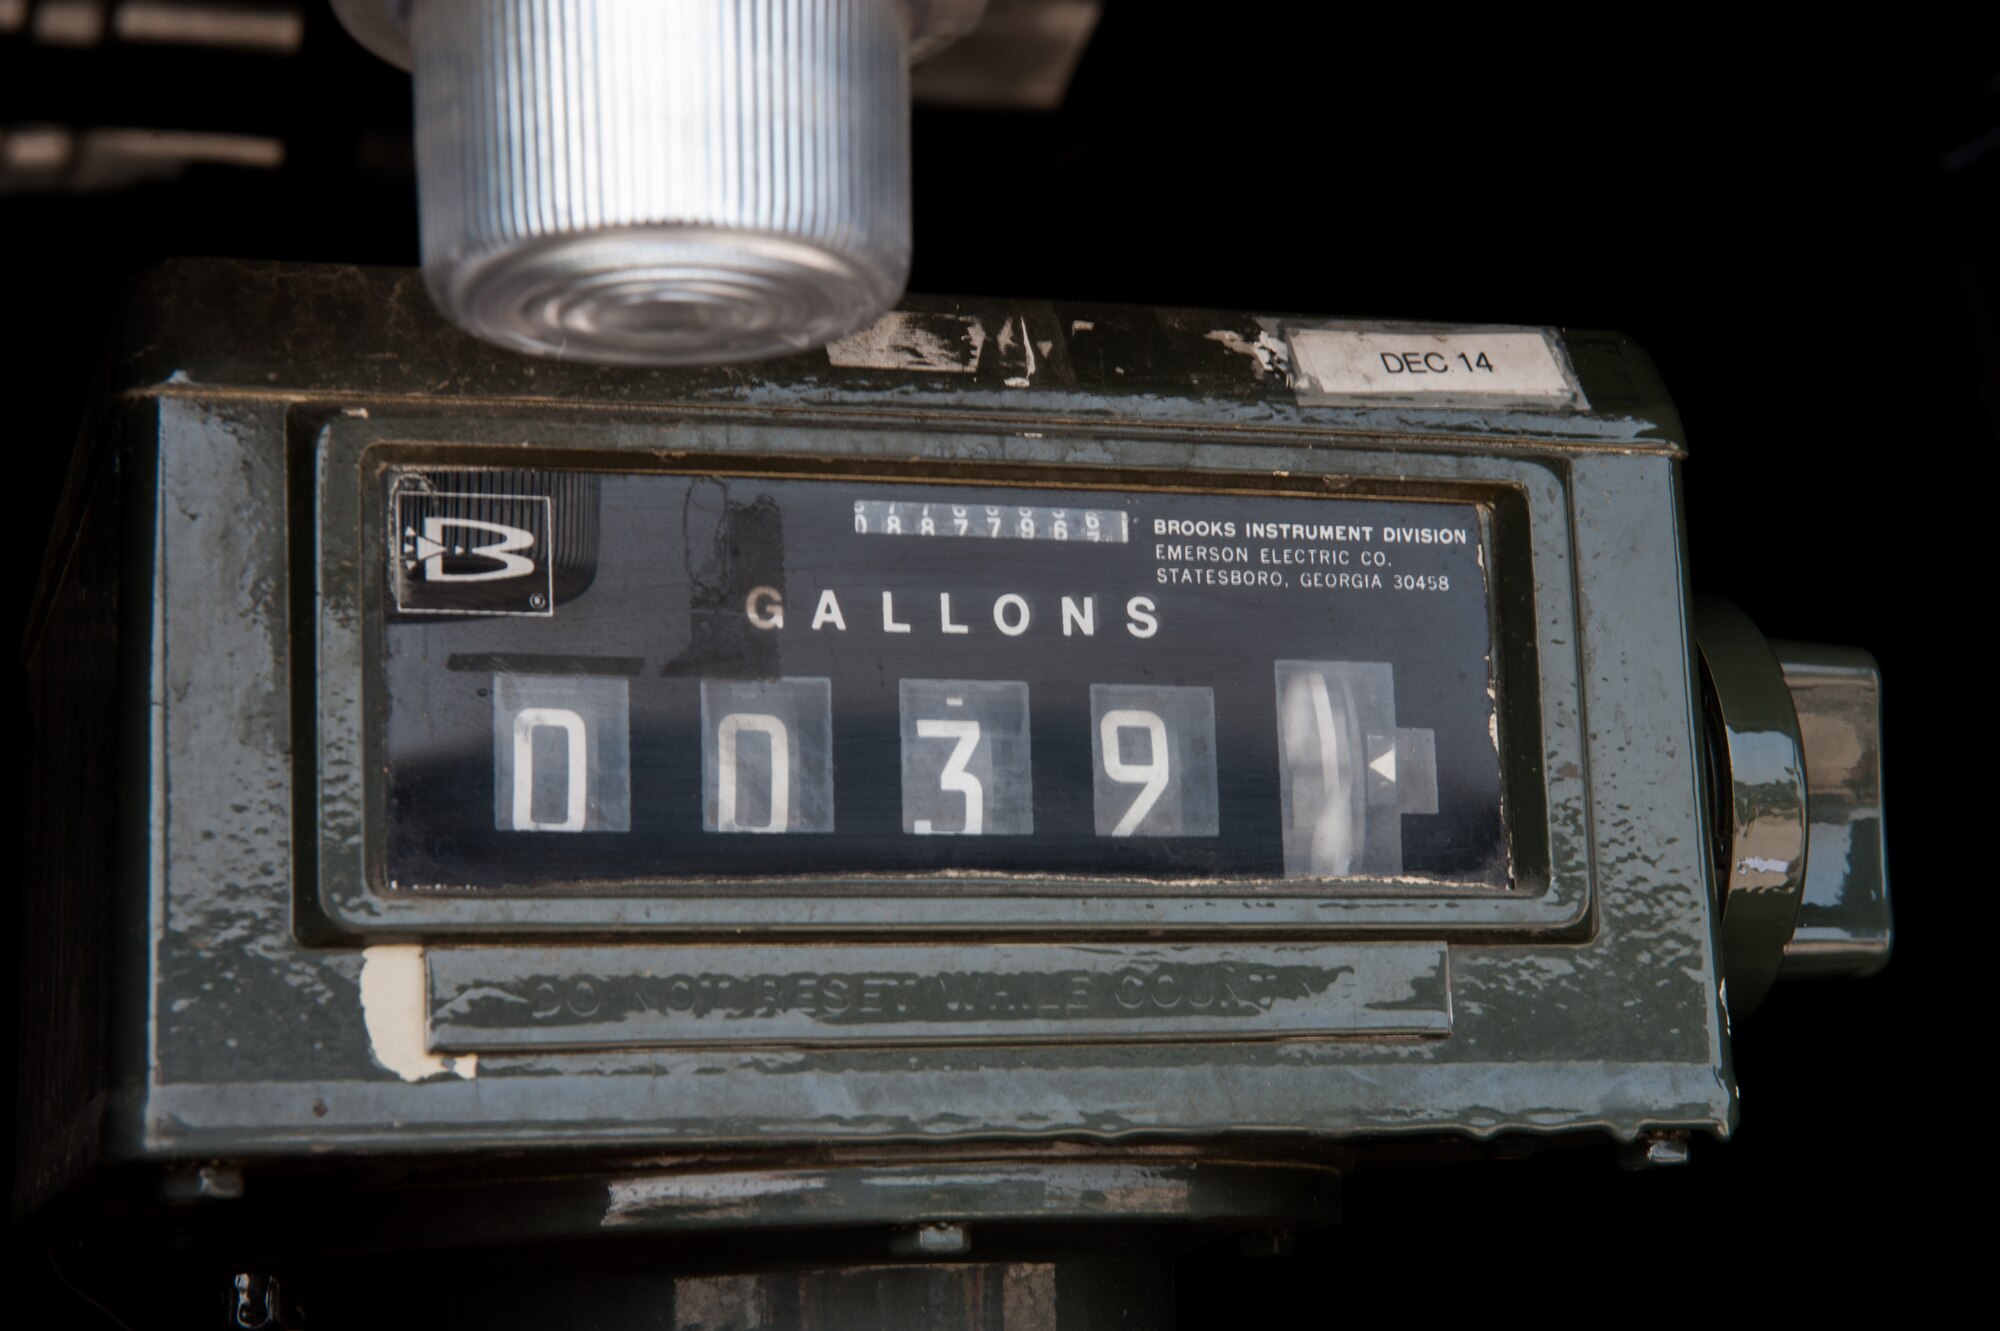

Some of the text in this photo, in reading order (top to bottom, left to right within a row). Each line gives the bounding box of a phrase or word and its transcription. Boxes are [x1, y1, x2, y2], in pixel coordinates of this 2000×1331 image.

[1457, 351, 1494, 373] 14
[1153, 518, 1467, 545] BROOKS INSTRUMENT DIVISION
[1155, 544, 1393, 568] EMERSON ELECTRIC CO.
[1156, 567, 1450, 592] STATESBORO, GEORGIA 30458
[745, 584, 1159, 639] GALLONS
